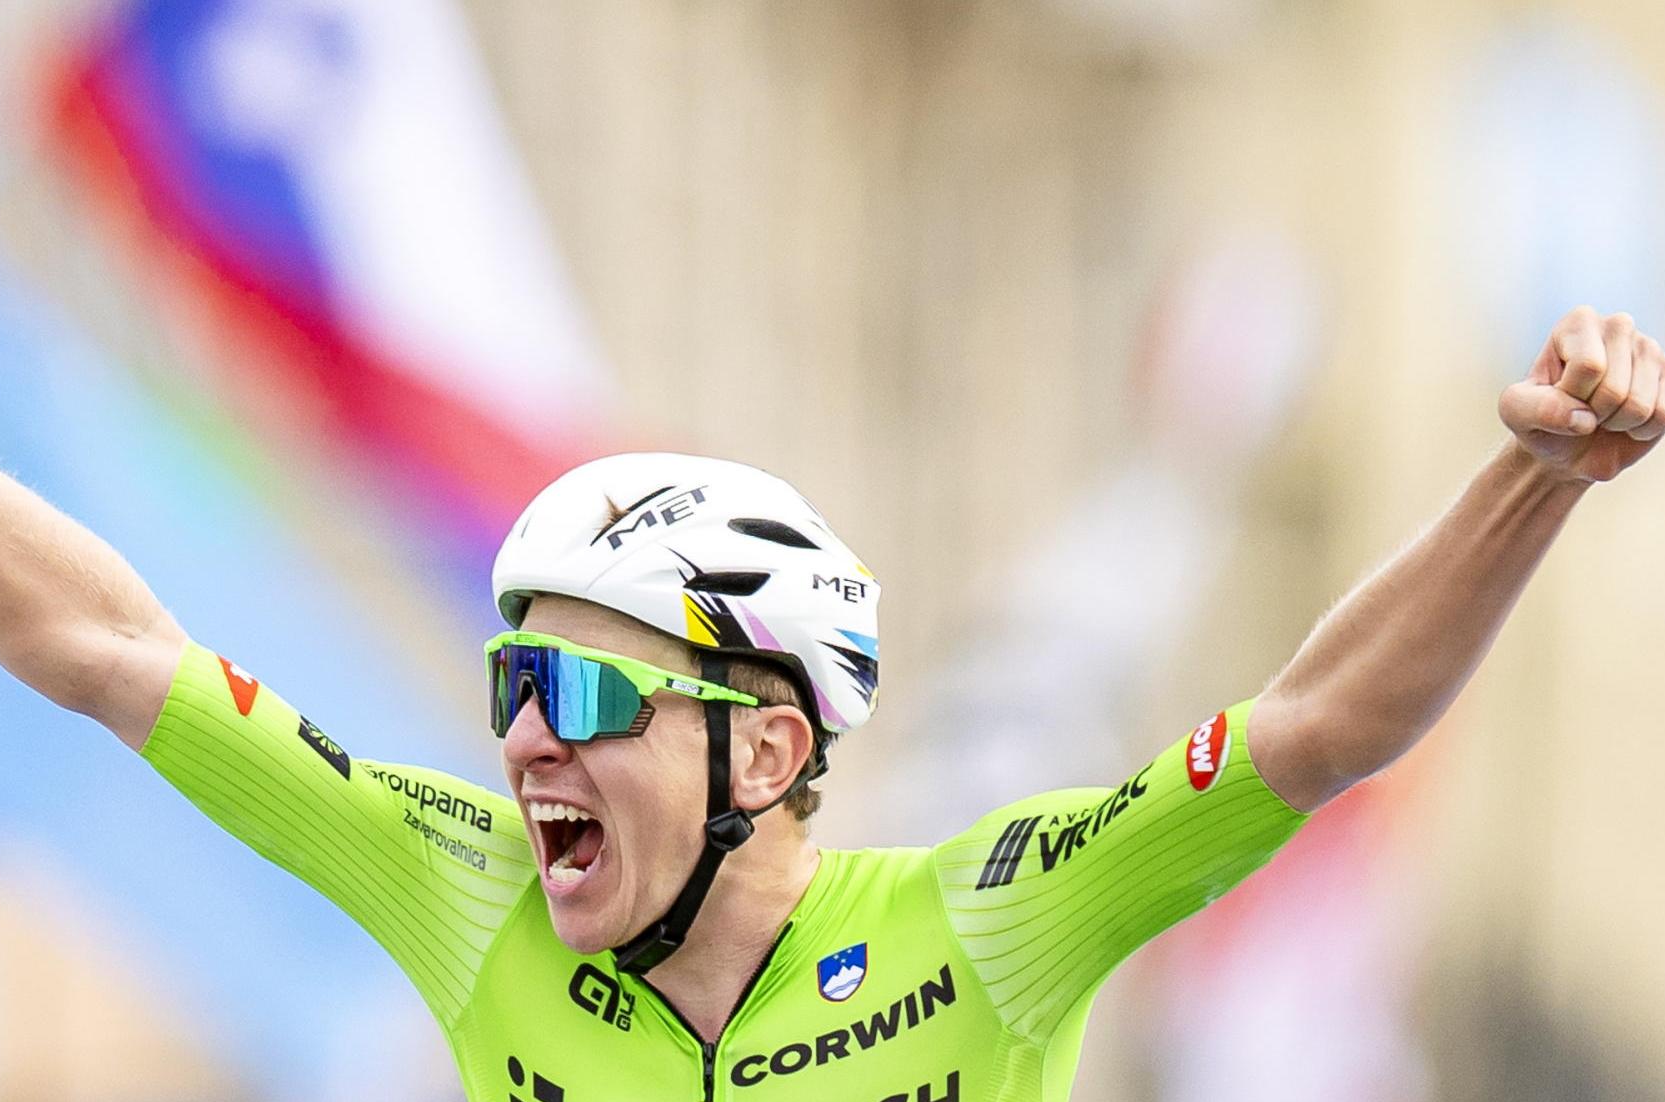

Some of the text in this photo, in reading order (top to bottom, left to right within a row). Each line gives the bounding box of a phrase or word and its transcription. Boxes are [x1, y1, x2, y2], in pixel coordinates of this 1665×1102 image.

[607, 485, 709, 550] MET
[812, 573, 868, 604] MET
[730, 963, 957, 1088] CORWIN
